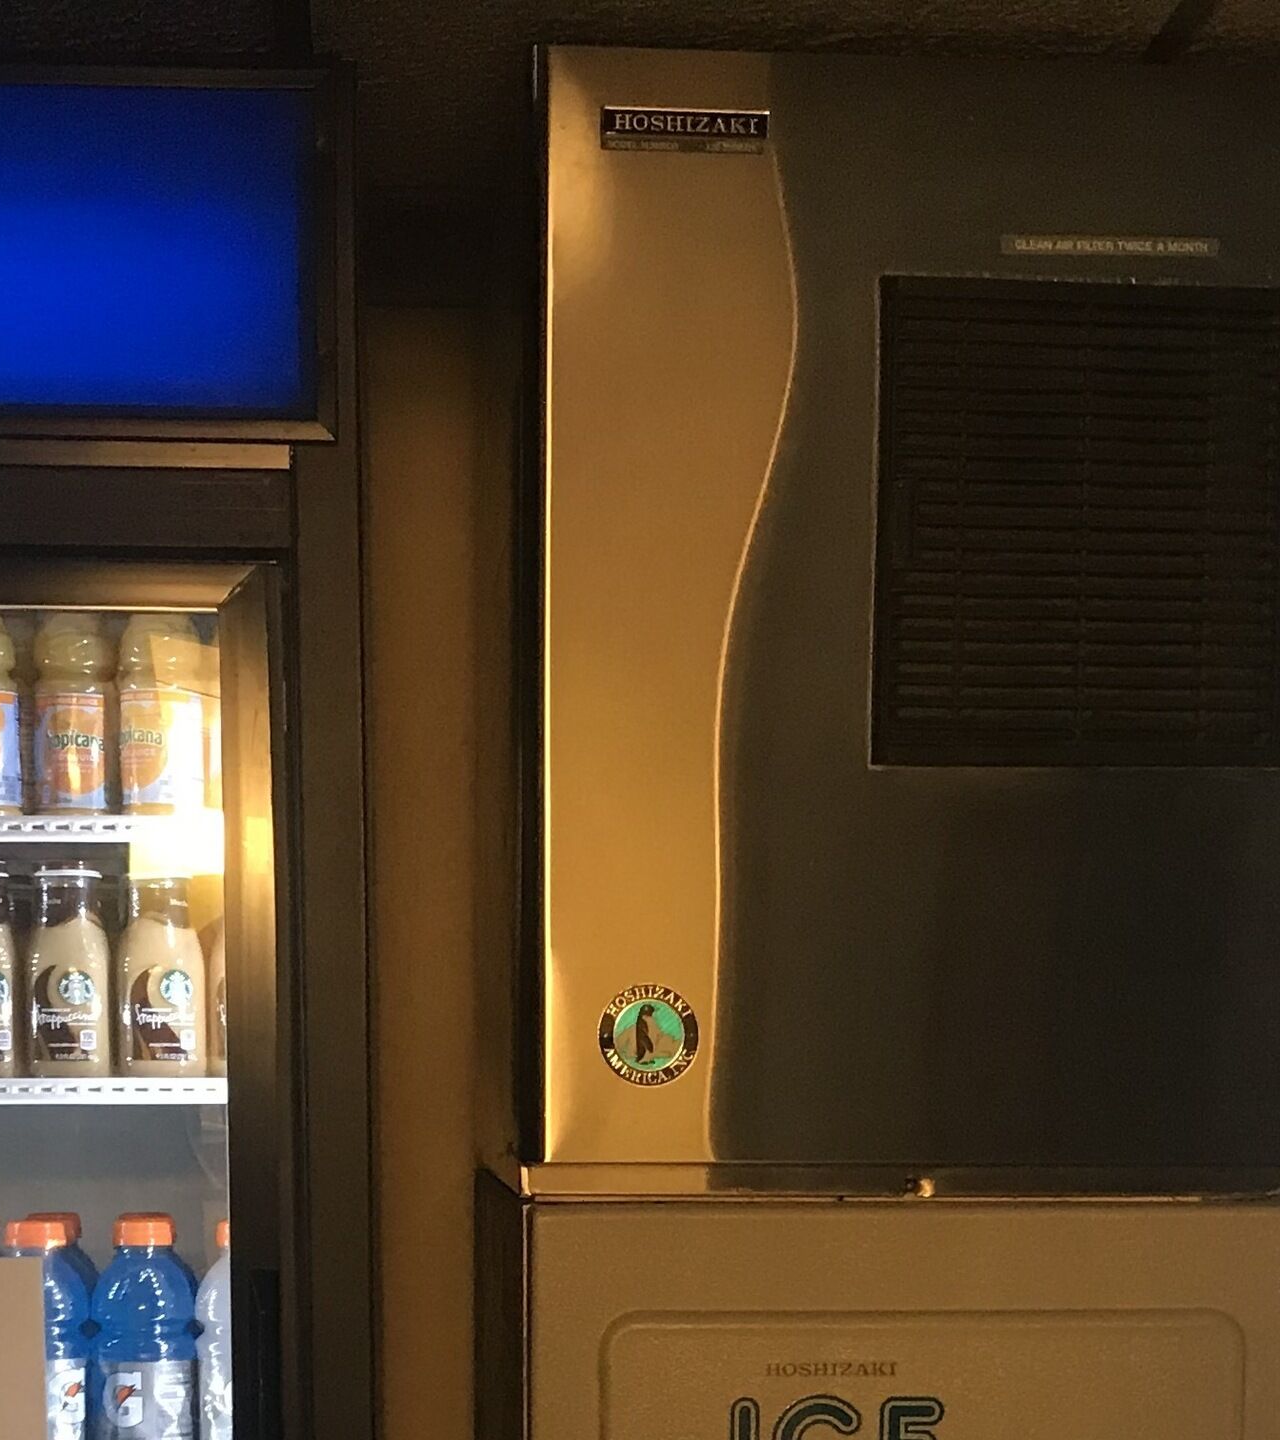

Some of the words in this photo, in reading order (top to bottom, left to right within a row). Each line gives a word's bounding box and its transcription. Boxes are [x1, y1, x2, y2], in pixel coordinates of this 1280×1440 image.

[614, 113, 759, 135] HOSHIZAKI
[606, 984, 692, 1017] HOSHIZAKI
[765, 1361, 898, 1378] HOSHIZAKI
[102, 1371, 144, 1428] G
